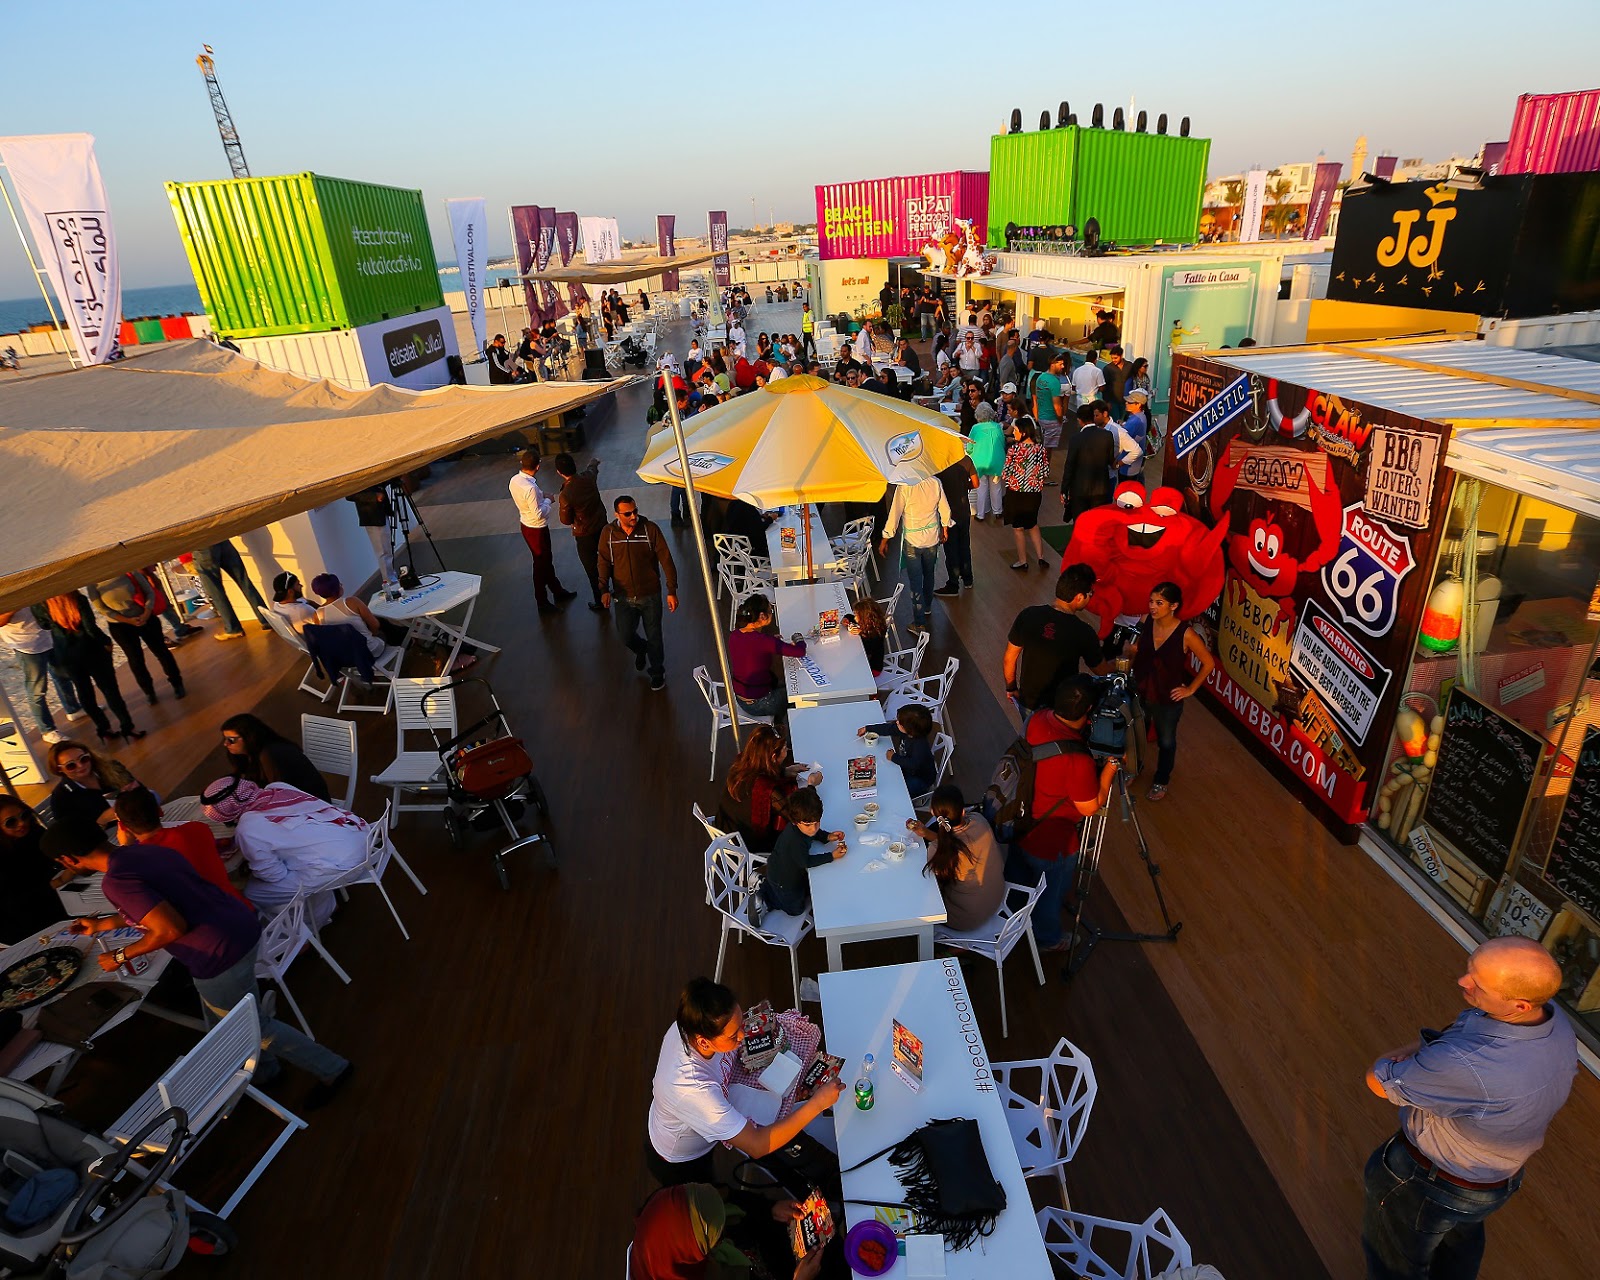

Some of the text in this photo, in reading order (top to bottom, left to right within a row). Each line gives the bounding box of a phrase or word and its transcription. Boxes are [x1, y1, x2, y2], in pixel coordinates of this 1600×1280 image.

[824, 205, 873, 223] BEACH
[824, 220, 893, 238] CANTEEN
[909, 213, 949, 223] FOOD 2015
[909, 221, 949, 231] FESTIVAL
[1377, 207, 1457, 268] JJ
[1184, 271, 1240, 284] Fatto in Casa
[389, 341, 418, 367] etisalat
[1177, 385, 1245, 449] CLAWTASTIC
[1312, 395, 1373, 450] CLAW
[1244, 456, 1304, 490] CLAW
[1382, 433, 1422, 476] BBQ
[1376, 469, 1422, 498] LOVERS
[1372, 489, 1421, 522] WANTED
[1351, 515, 1401, 567] ROUTE
[1331, 547, 1385, 622] 66
[1243, 598, 1273, 639] BBQ
[1224, 615, 1287, 676] CRABSHACK
[1320, 621, 1368, 673] WARNING
[1229, 644, 1271, 692] GRILL
[1298, 650, 1320, 680] WORLDS
[1318, 673, 1335, 695] BEST
[1332, 689, 1362, 725] BARBECUE
[1301, 631, 1372, 711] YOU ARE ABOUT TO EAT THE
[1413, 835, 1430, 855] HOT
[1424, 857, 1439, 877] ROD
[1491, 909, 1511, 928] DOP
[1502, 880, 1548, 921] PY TOILET
[941, 959, 994, 1094] #beachcanteen
